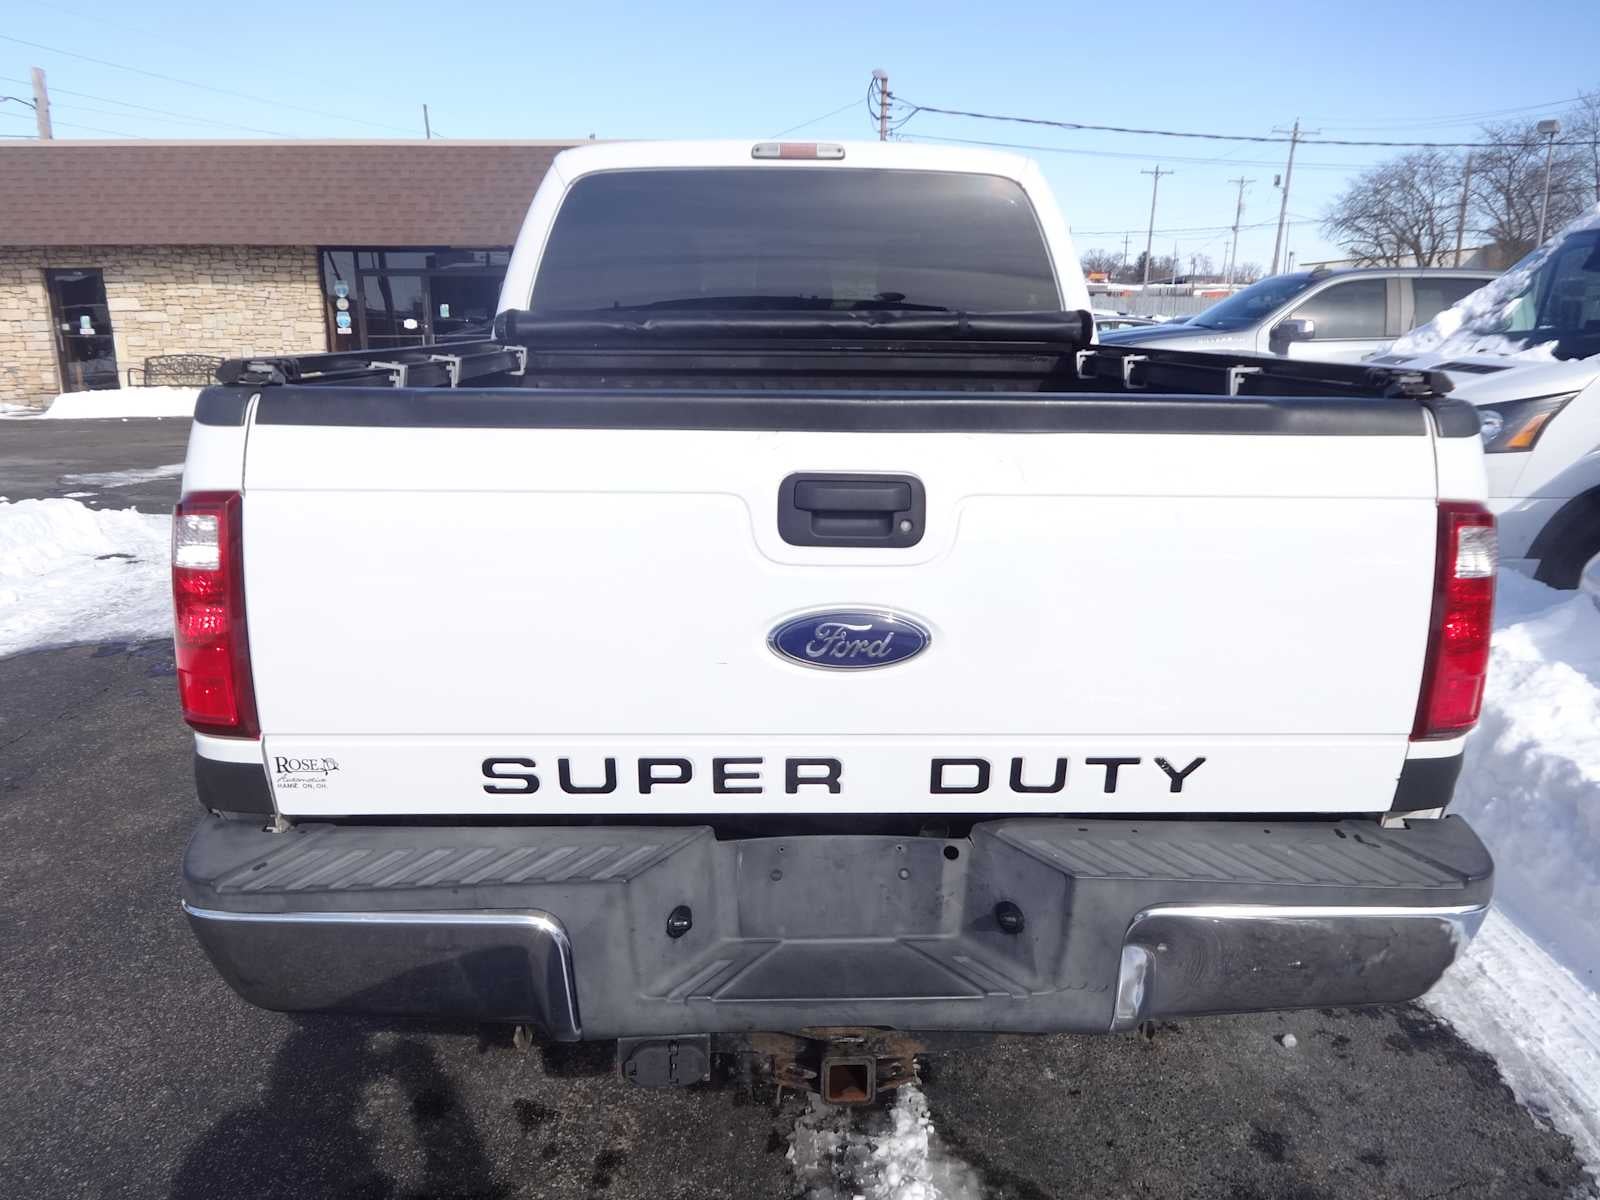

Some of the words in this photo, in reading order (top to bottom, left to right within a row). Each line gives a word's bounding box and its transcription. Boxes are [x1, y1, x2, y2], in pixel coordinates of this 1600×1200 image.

[806, 622, 894, 657] Ford
[481, 757, 842, 795] SUPER
[929, 757, 1207, 795] DUTY
